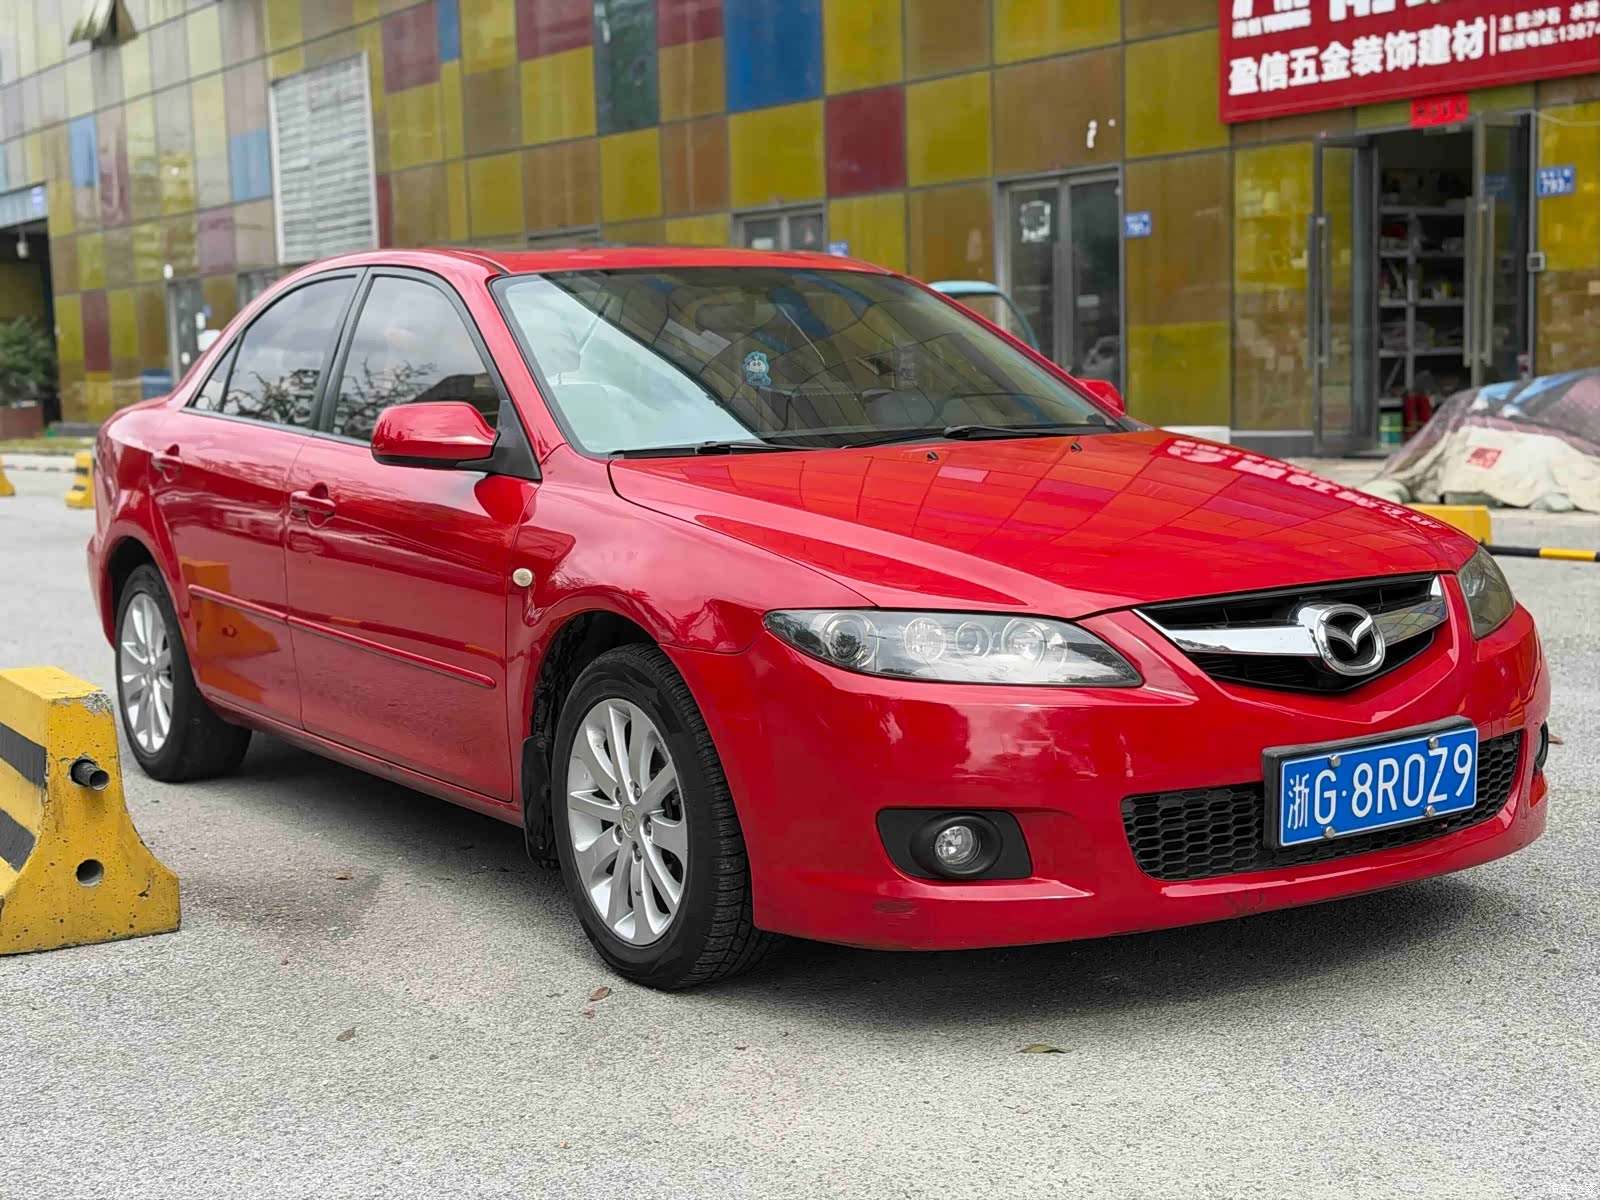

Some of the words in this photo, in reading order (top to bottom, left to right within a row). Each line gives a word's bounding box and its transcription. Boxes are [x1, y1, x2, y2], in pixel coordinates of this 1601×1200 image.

[1228, 16, 1488, 96] 盈信五金装饰建材
[1287, 743, 1473, 830] 浙G·8R0Z9
